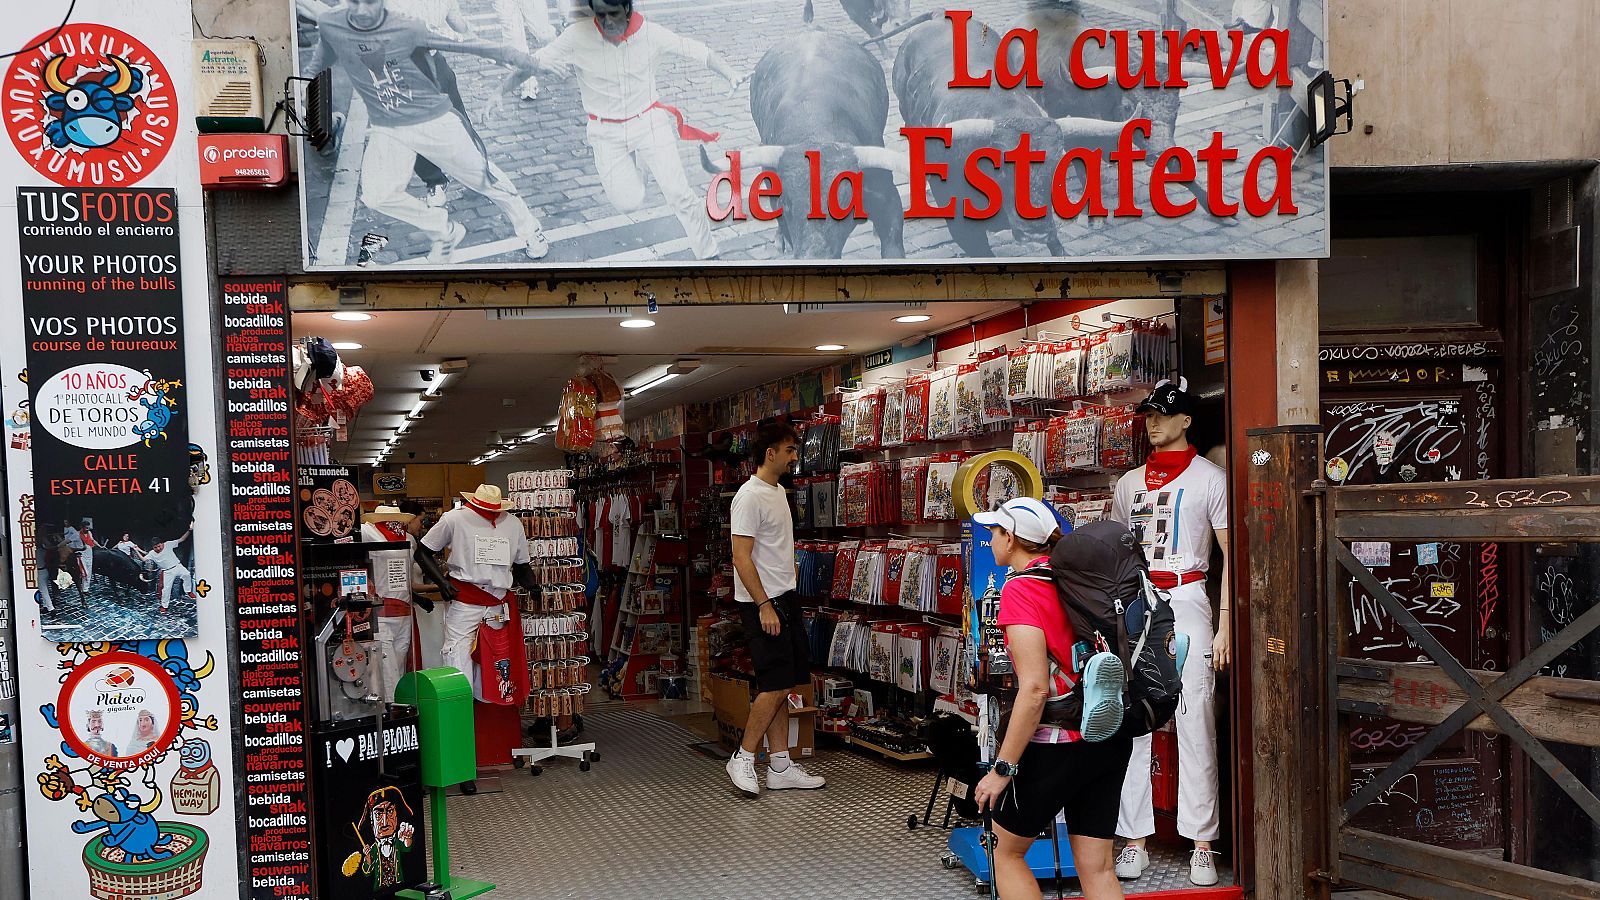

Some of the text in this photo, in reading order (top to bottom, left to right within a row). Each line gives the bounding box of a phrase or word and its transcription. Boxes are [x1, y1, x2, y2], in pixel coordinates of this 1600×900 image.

[945, 10, 1295, 91] La curva
[223, 146, 278, 161] prodein
[706, 118, 1298, 221] de la Estafeta
[21, 192, 173, 222] TUSFOTOS
[23, 222, 174, 236] corriendo el encierro
[24, 254, 177, 274] YOUR PHOTOS
[27, 276, 176, 293] running of the bulls
[225, 281, 282, 293] souvenir
[224, 293, 268, 305] bebida
[246, 300, 284, 315] snak
[29, 316, 177, 336] VOS PHOTOS
[224, 315, 284, 328] bocadillos
[241, 328, 284, 337] productos
[32, 337, 177, 351] course de taureaux
[226, 342, 284, 352] navarros
[227, 353, 286, 364] camisetas
[228, 365, 286, 378] souvenir
[61, 371, 127, 391] 10 AÑOS
[228, 378, 271, 390] bebida
[249, 385, 287, 399] snak
[65, 393, 123, 405] PHOTOCALL
[228, 399, 287, 412] bocadillos
[49, 407, 139, 424] DE TOROS
[245, 413, 287, 422] productos
[63, 426, 127, 438] DEL MUNDO
[230, 426, 288, 437] navarros
[230, 438, 290, 448] camisetas
[232, 449, 290, 461] souvenir
[84, 454, 138, 471] CALLE
[232, 462, 275, 473] bebida
[253, 468, 291, 483] snak
[308, 467, 318, 476] tu
[319, 467, 349, 476] moneda
[51, 478, 171, 496] ESTAFETA 41
[232, 483, 291, 496] bocadillos
[248, 496, 290, 505] productos
[233, 510, 292, 521] navarros
[234, 521, 293, 532] camisetas
[235, 532, 293, 545] souvenir
[236, 545, 279, 557] bebida
[257, 551, 294, 566] snak
[236, 566, 295, 579] bocadillos
[252, 578, 295, 588] productos
[238, 592, 296, 604] navarros
[238, 604, 297, 615] camisetas
[239, 616, 297, 629] souvenir
[240, 629, 283, 641] bebida
[261, 635, 299, 649] snak
[240, 649, 299, 664] bocadillos
[256, 662, 299, 671] productos
[242, 676, 300, 688] navarros
[97, 693, 144, 706] Platero
[243, 687, 301, 699] camisetas
[244, 700, 301, 713] souvenir
[244, 712, 287, 725] bebida
[265, 718, 303, 733] snak
[244, 733, 303, 747] bocadillos
[325, 724, 420, 768] I PAPLONA
[261, 745, 303, 755] productos
[87, 746, 161, 769] DE VENTA AQUÍ
[246, 759, 304, 771] navarros
[247, 770, 305, 782] camisetas
[248, 781, 305, 794] souvenir
[248, 793, 291, 806] bebida
[269, 800, 307, 815] snak
[248, 814, 307, 828] bocadillos
[265, 826, 307, 836] productos
[250, 840, 308, 852] navarros
[251, 851, 309, 863] camisetas
[252, 863, 310, 877] souvenir
[252, 875, 295, 888] bebida
[273, 881, 310, 896] snak
